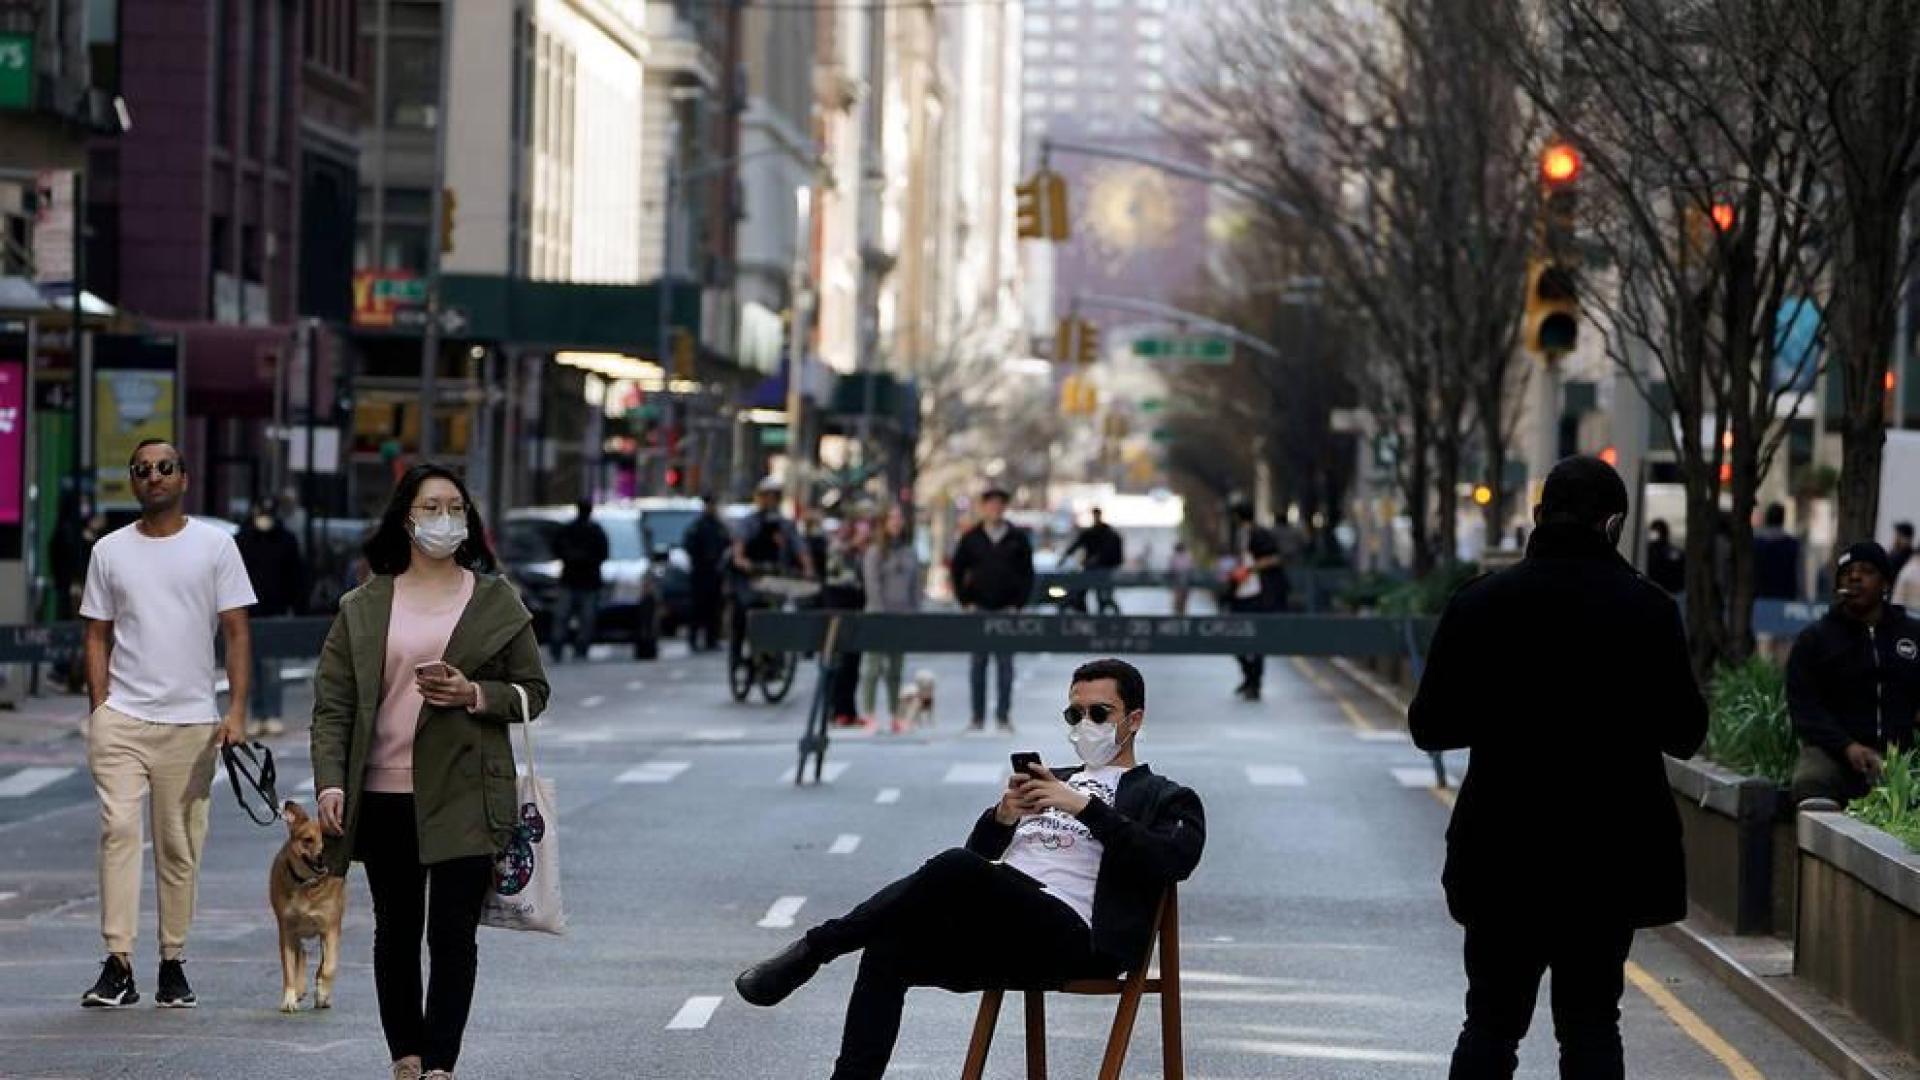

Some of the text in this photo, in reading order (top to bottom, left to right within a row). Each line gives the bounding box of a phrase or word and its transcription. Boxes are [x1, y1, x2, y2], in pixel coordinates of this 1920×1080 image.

[983, 619, 1043, 635] POLICE
[1060, 619, 1098, 636] LINE
[1157, 619, 1191, 635] NOT
